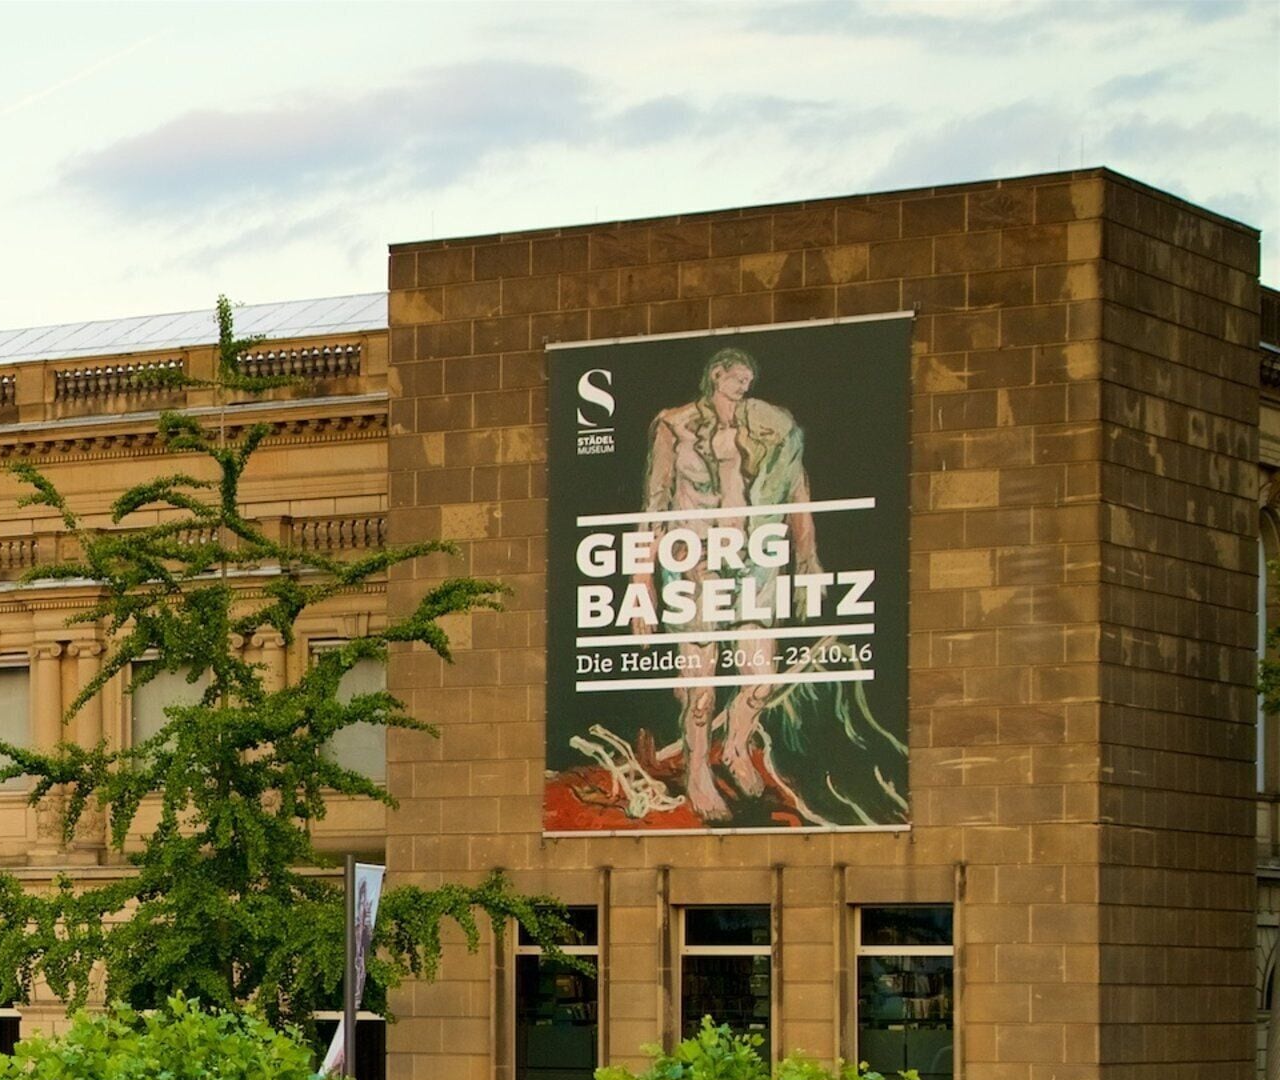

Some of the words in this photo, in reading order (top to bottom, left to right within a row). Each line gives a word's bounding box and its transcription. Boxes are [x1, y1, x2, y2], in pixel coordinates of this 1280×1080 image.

[577, 368, 615, 427] S
[577, 434, 615, 446] STÄDEL
[577, 444, 615, 455] MUSEUM
[576, 522, 791, 578] GEORG
[576, 570, 876, 629] BASELITZ
[576, 654, 613, 674] Die
[621, 651, 701, 673] Helden
